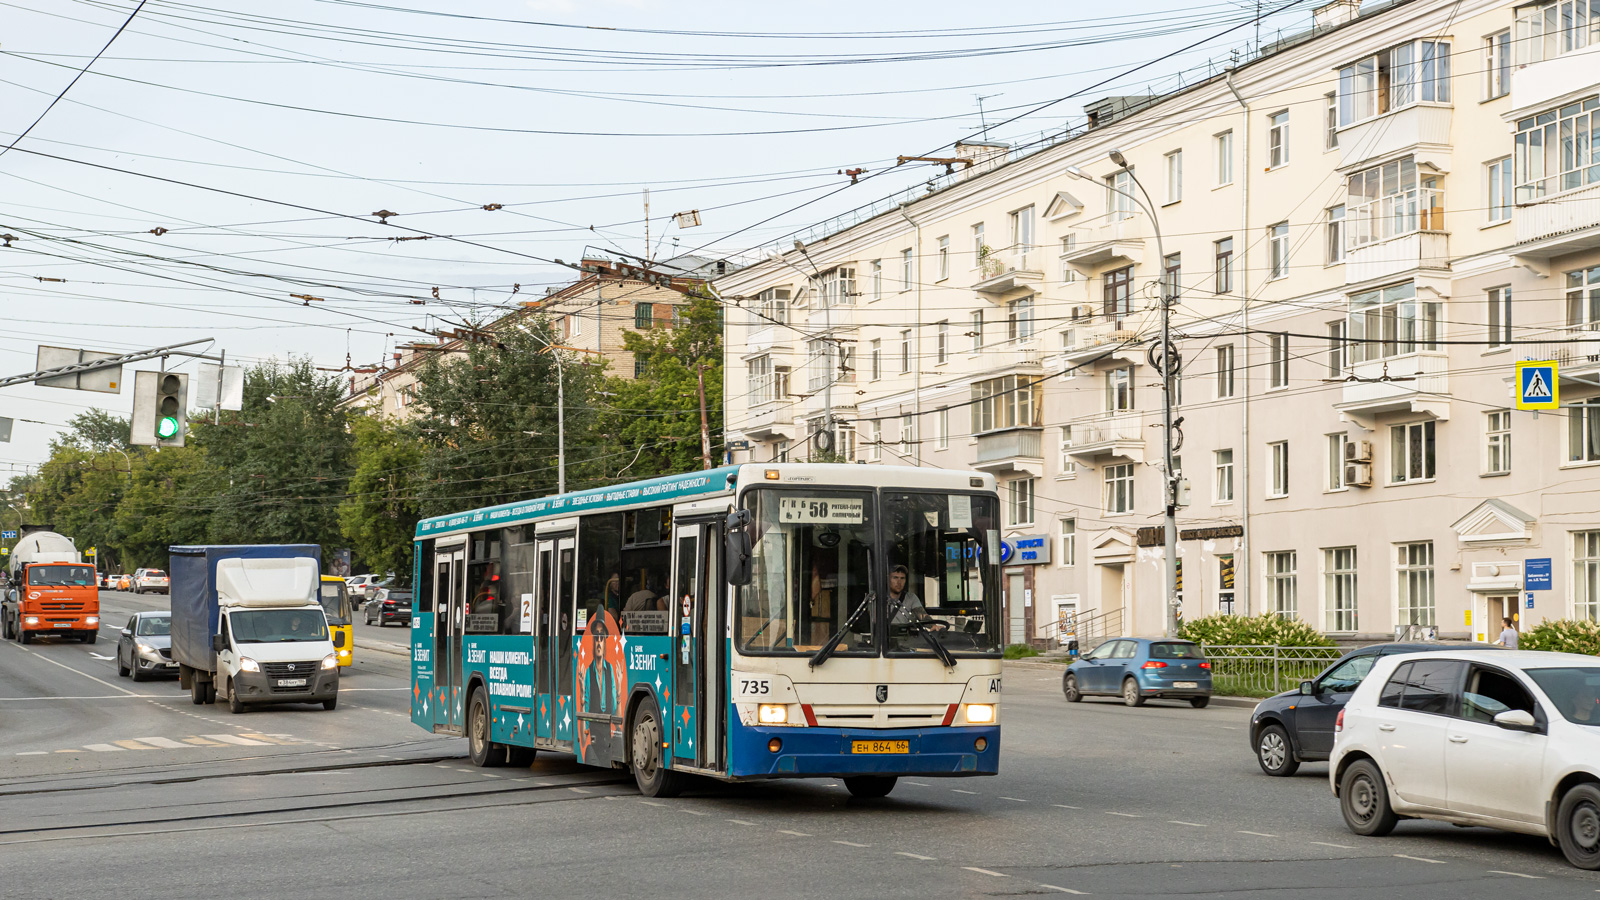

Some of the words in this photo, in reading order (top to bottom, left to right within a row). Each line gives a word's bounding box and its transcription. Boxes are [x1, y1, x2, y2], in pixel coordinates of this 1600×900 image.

[809, 501, 829, 518] 58
[1021, 551, 1037, 560] FORD
[523, 600, 530, 618] 2
[417, 649, 430, 661] ЗЕНИТ
[471, 650, 486, 663] ЗЕНИТ
[490, 651, 504, 664] НАШИ
[505, 651, 529, 665] КЛИЕНТЫ
[634, 654, 656, 670] ЗЕНИТ
[490, 667, 507, 682] ВСЕГДА
[490, 682, 493, 695] В
[494, 680, 515, 697] ГЛАВНОЙ
[516, 684, 532, 698] РОЛИ!
[741, 680, 769, 694] 735
[873, 742, 890, 752] 864
[896, 741, 906, 749] 66
